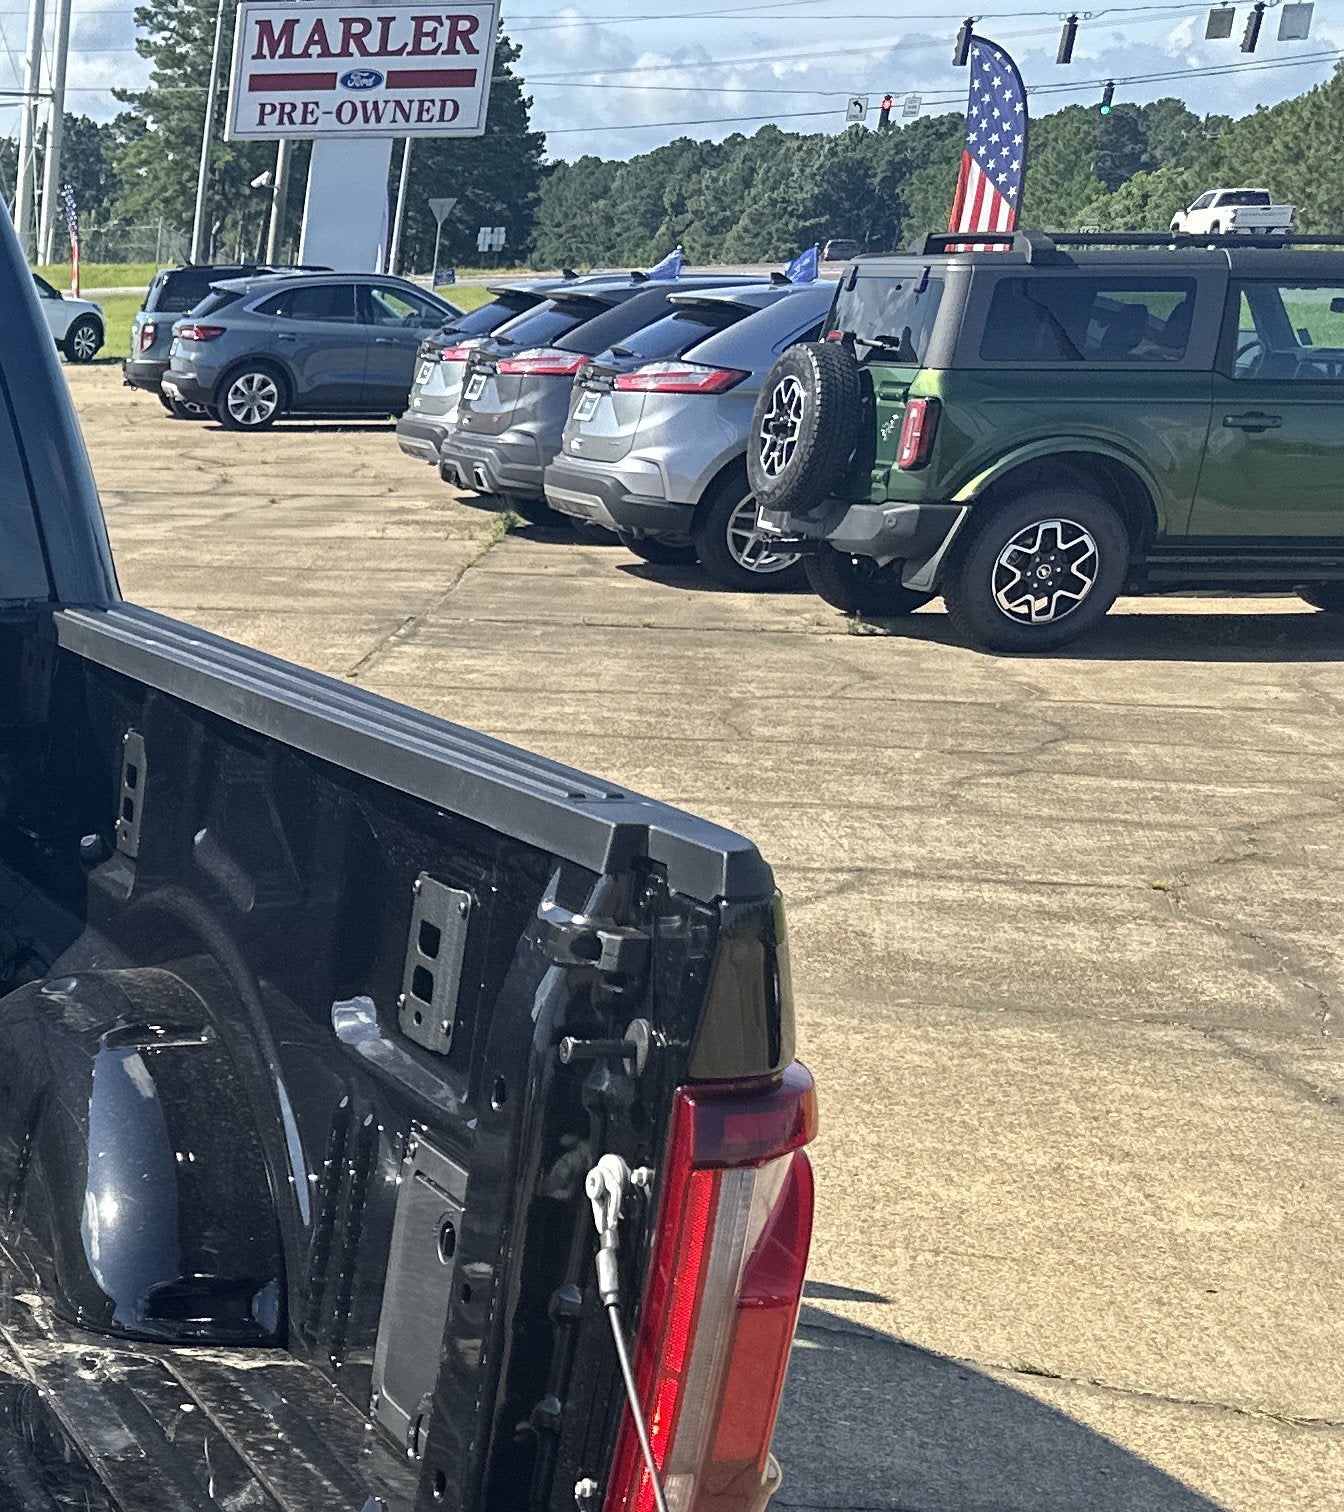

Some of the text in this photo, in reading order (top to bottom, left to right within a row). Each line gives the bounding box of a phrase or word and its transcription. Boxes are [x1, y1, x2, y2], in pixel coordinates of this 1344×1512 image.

[251, 14, 480, 60] MARLER
[347, 72, 375, 87] Ford
[256, 98, 460, 126] PRE-OWNED
